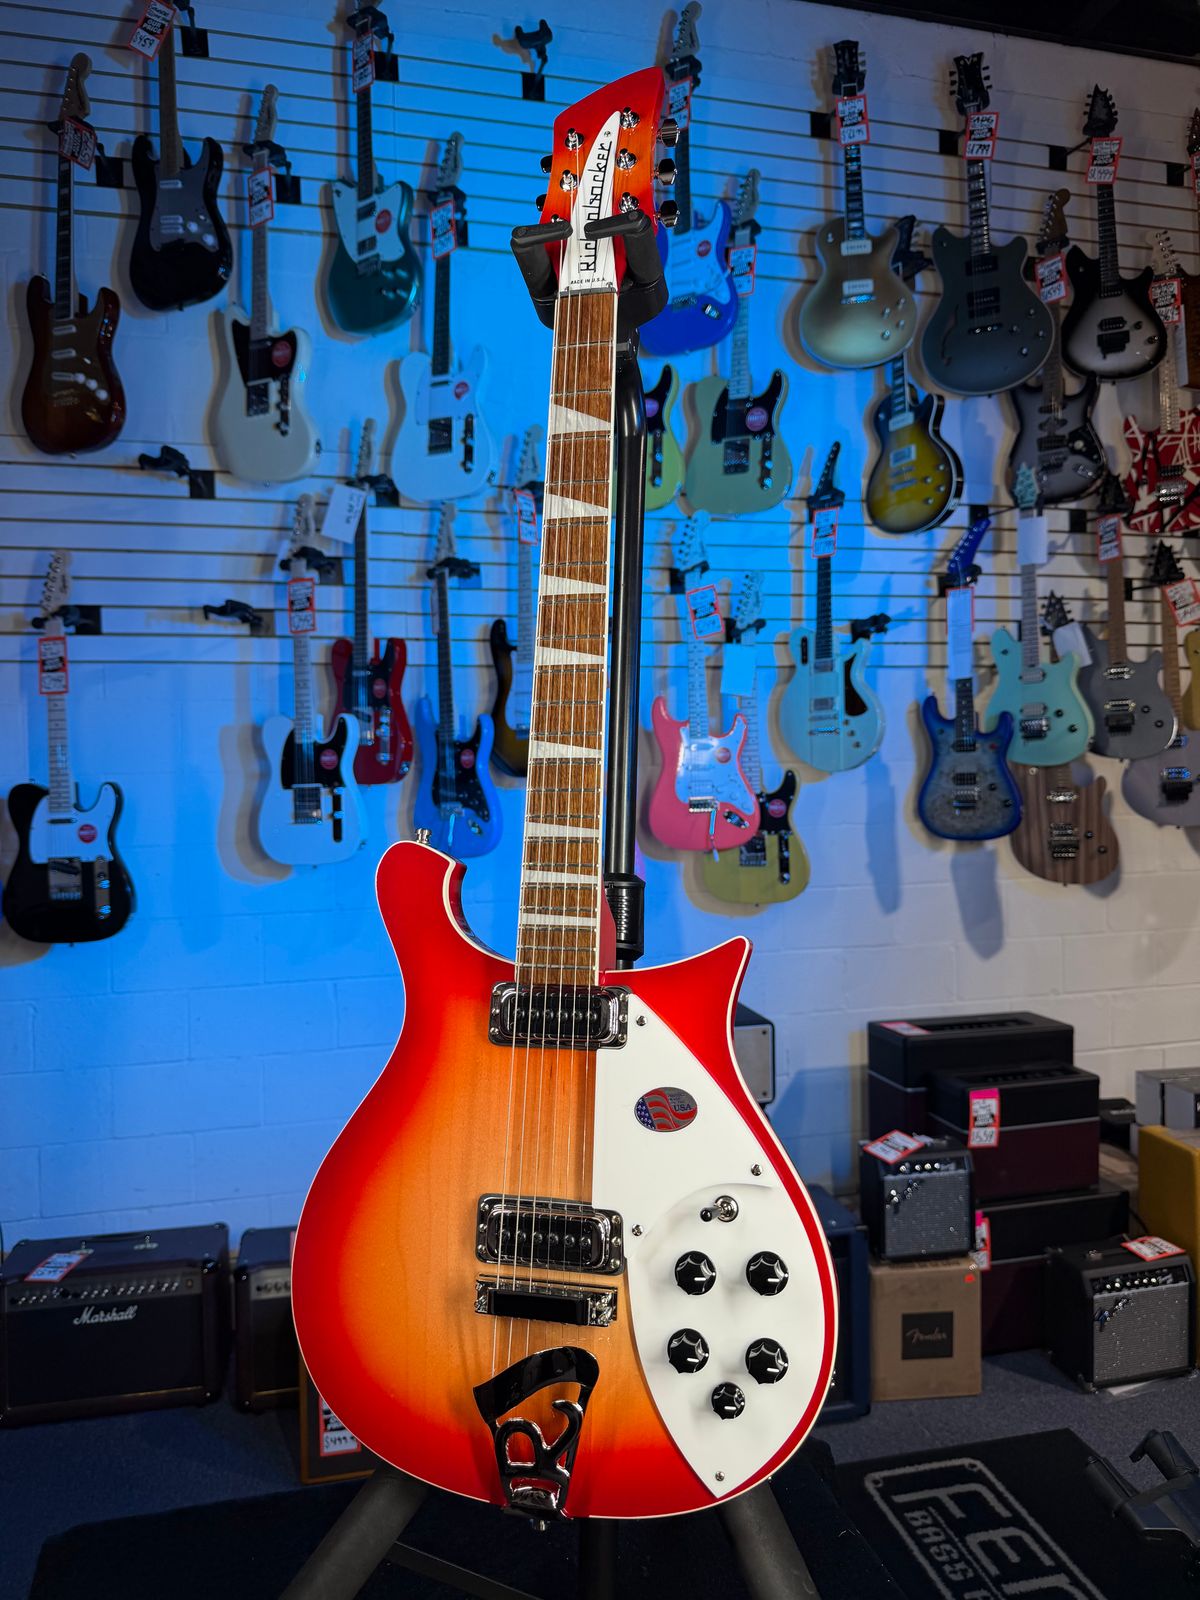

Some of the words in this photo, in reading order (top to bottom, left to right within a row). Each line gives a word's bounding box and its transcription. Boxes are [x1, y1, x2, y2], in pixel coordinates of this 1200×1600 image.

[578, 141, 613, 274] Ricnbacker
[673, 1103, 692, 1112] USA
[73, 1304, 138, 1325] Marshall
